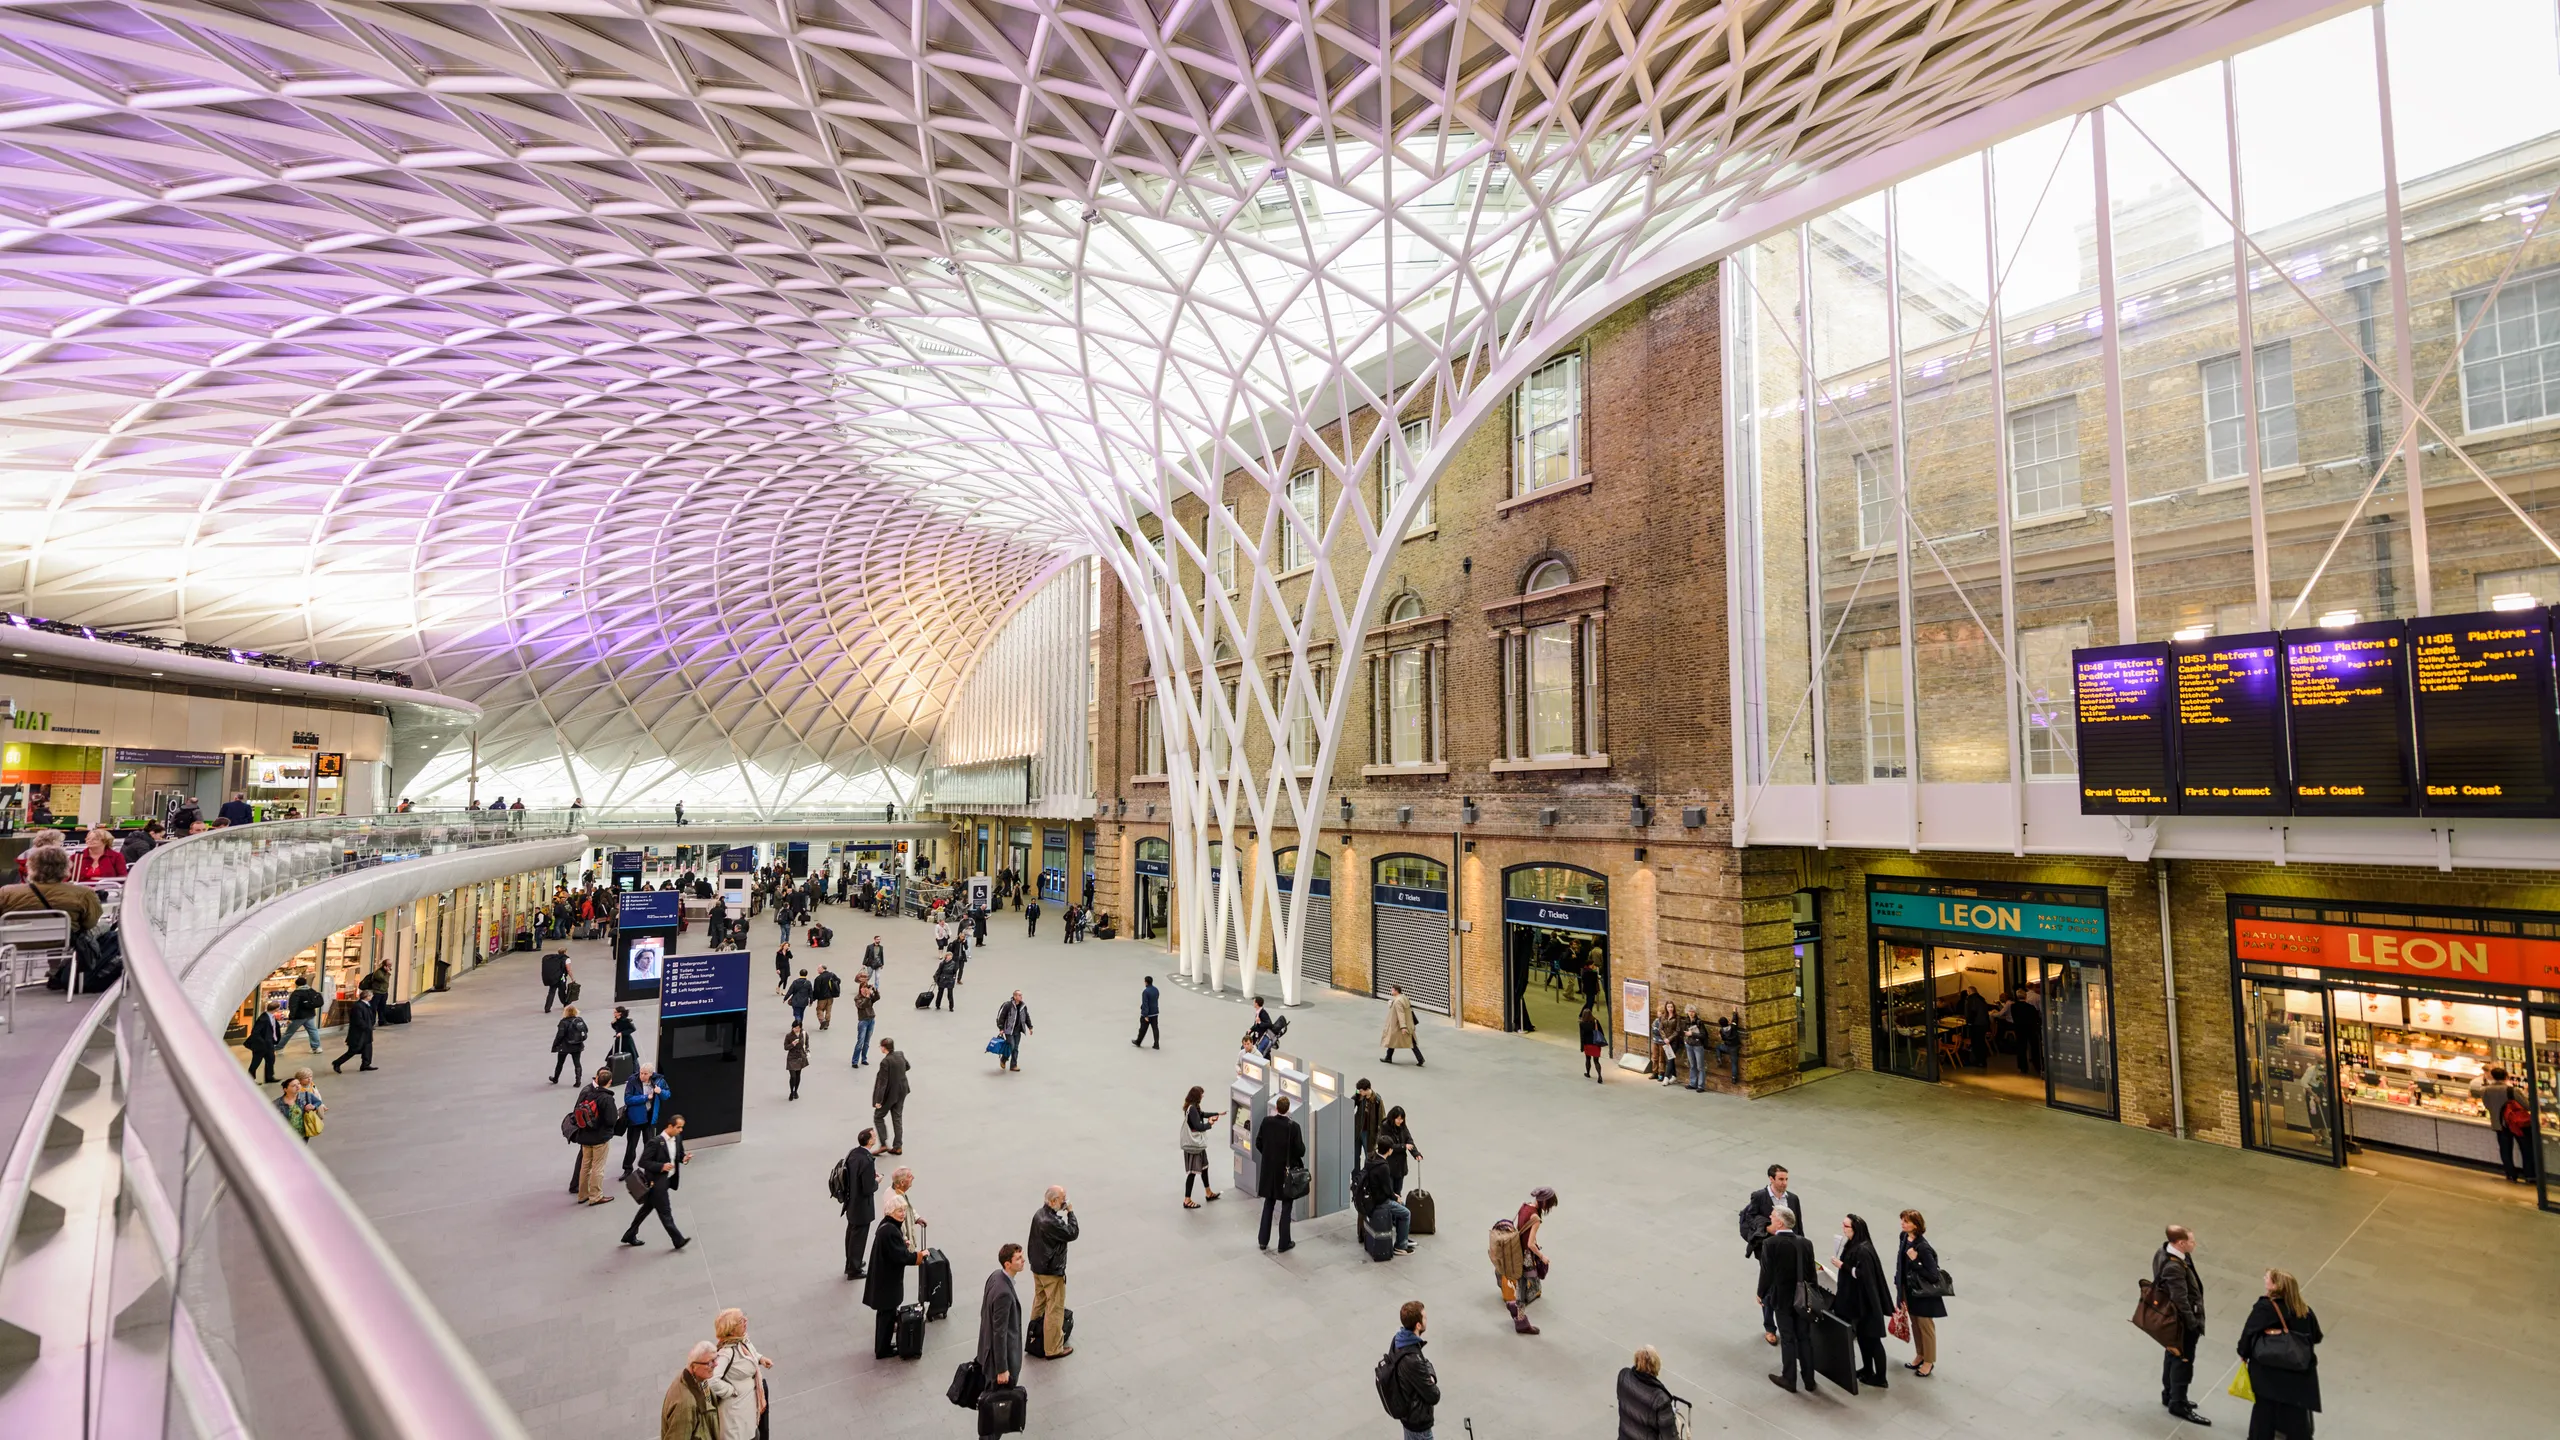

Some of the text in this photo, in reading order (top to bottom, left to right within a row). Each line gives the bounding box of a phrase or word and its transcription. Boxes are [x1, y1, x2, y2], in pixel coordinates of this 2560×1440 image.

[2419, 634, 2453, 645] 11:05
[2467, 629, 2526, 641] Platform
[2290, 644, 2321, 655] 11:00
[2334, 640, 2384, 651] Platform
[2417, 645, 2456, 656] Leeds
[2179, 649, 2274, 664] 10:53 Platform 10
[2290, 653, 2346, 665] Edinburgh
[2482, 652, 2504, 660] Page
[2506, 650, 2512, 658] 1
[2114, 660, 2153, 669] Platform
[2156, 658, 2164, 666] 5
[2178, 663, 2228, 673] Cambridge
[2419, 660, 2487, 670] Peterborough
[2078, 668, 2158, 680] Bradford Interch
[2419, 669, 2469, 677] Doncaster
[2291, 677, 2340, 685] Darlington
[2419, 673, 2517, 685] Wakefield Westgate
[2292, 684, 2336, 692] Newcastle
[14, 710, 52, 731] HAT
[2085, 788, 2150, 796] Grand Central
[2185, 786, 2271, 797] First Cap Connect
[2298, 786, 2364, 796] East Coast
[2427, 785, 2502, 796] East Coast
[1548, 911, 1569, 919] Tickets
[1939, 902, 2021, 932] LEON
[2038, 914, 2098, 925] NATURALLY
[2039, 923, 2098, 934] FAST FOOD
[2242, 932, 2320, 943] NATURALLY
[2244, 941, 2320, 953] FAST FOOD
[2348, 933, 2488, 974] LEON
